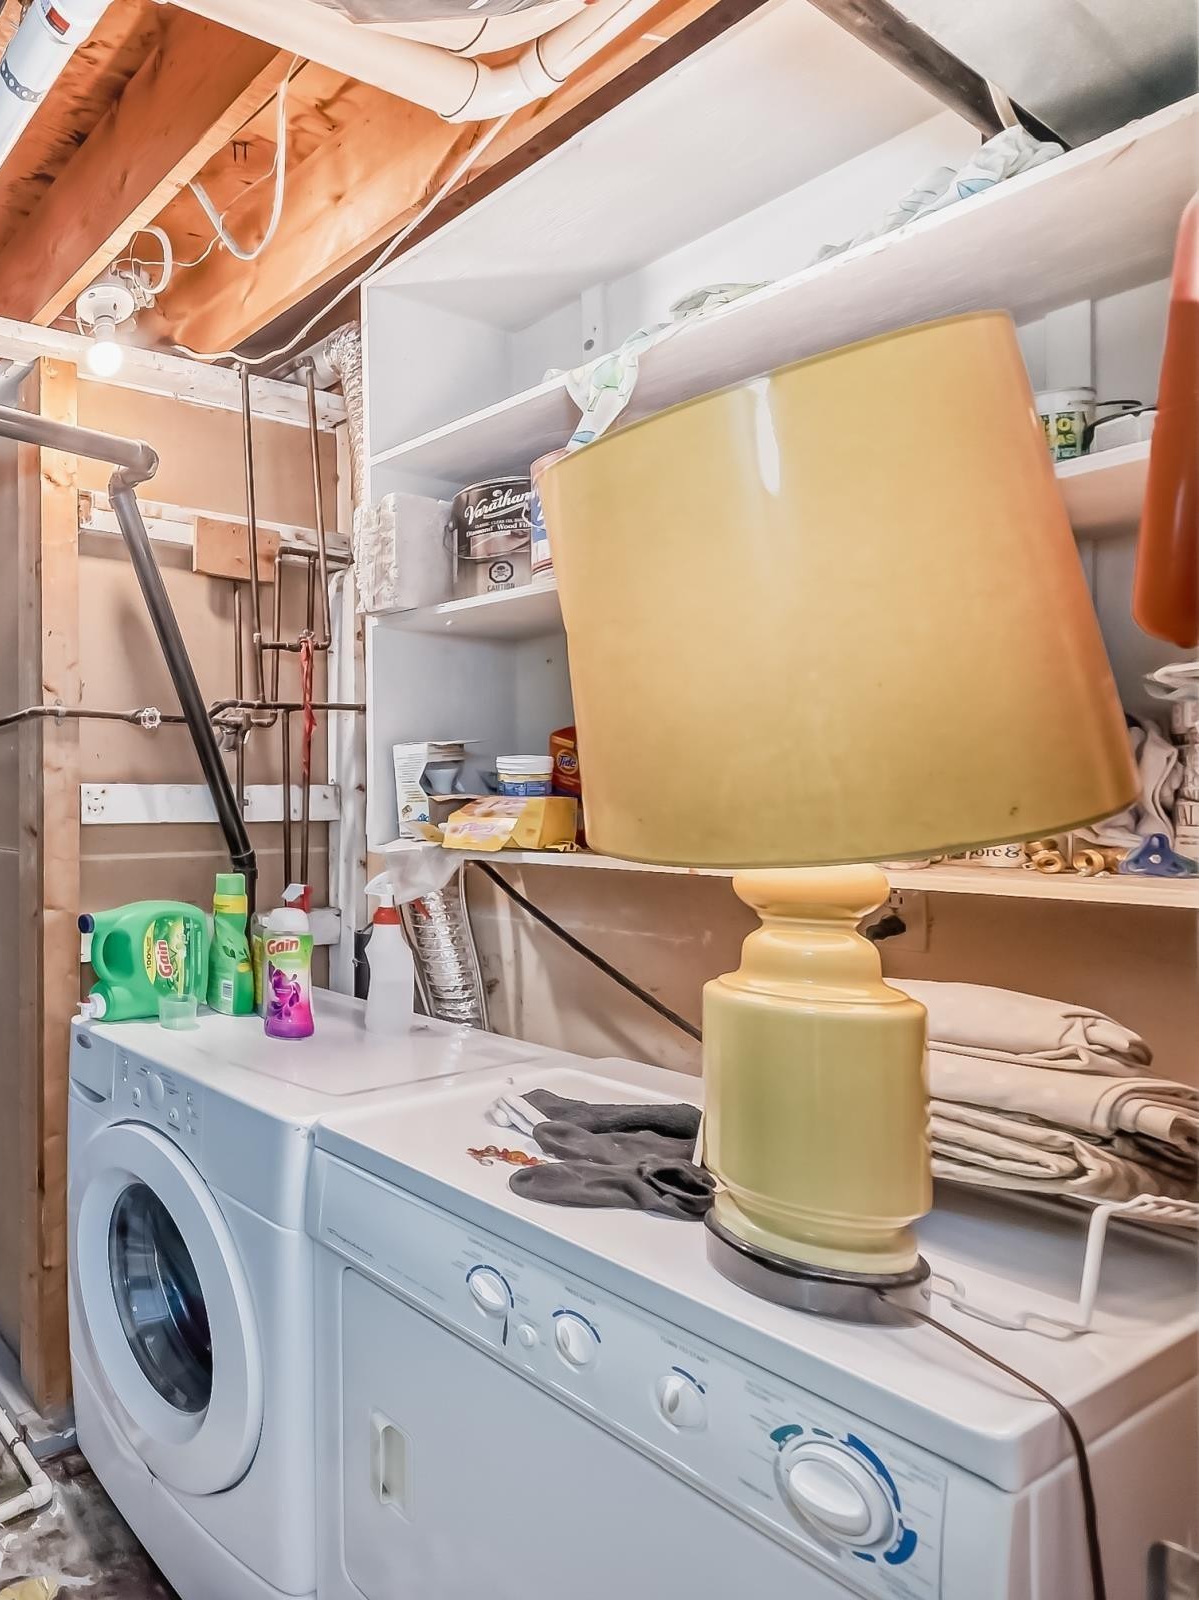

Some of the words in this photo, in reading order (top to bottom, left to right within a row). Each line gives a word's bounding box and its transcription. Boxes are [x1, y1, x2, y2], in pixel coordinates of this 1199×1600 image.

[464, 488, 535, 525] Varathan
[558, 755, 577, 768] Tide
[157, 940, 173, 977] Gain
[267, 939, 299, 955] Gain
